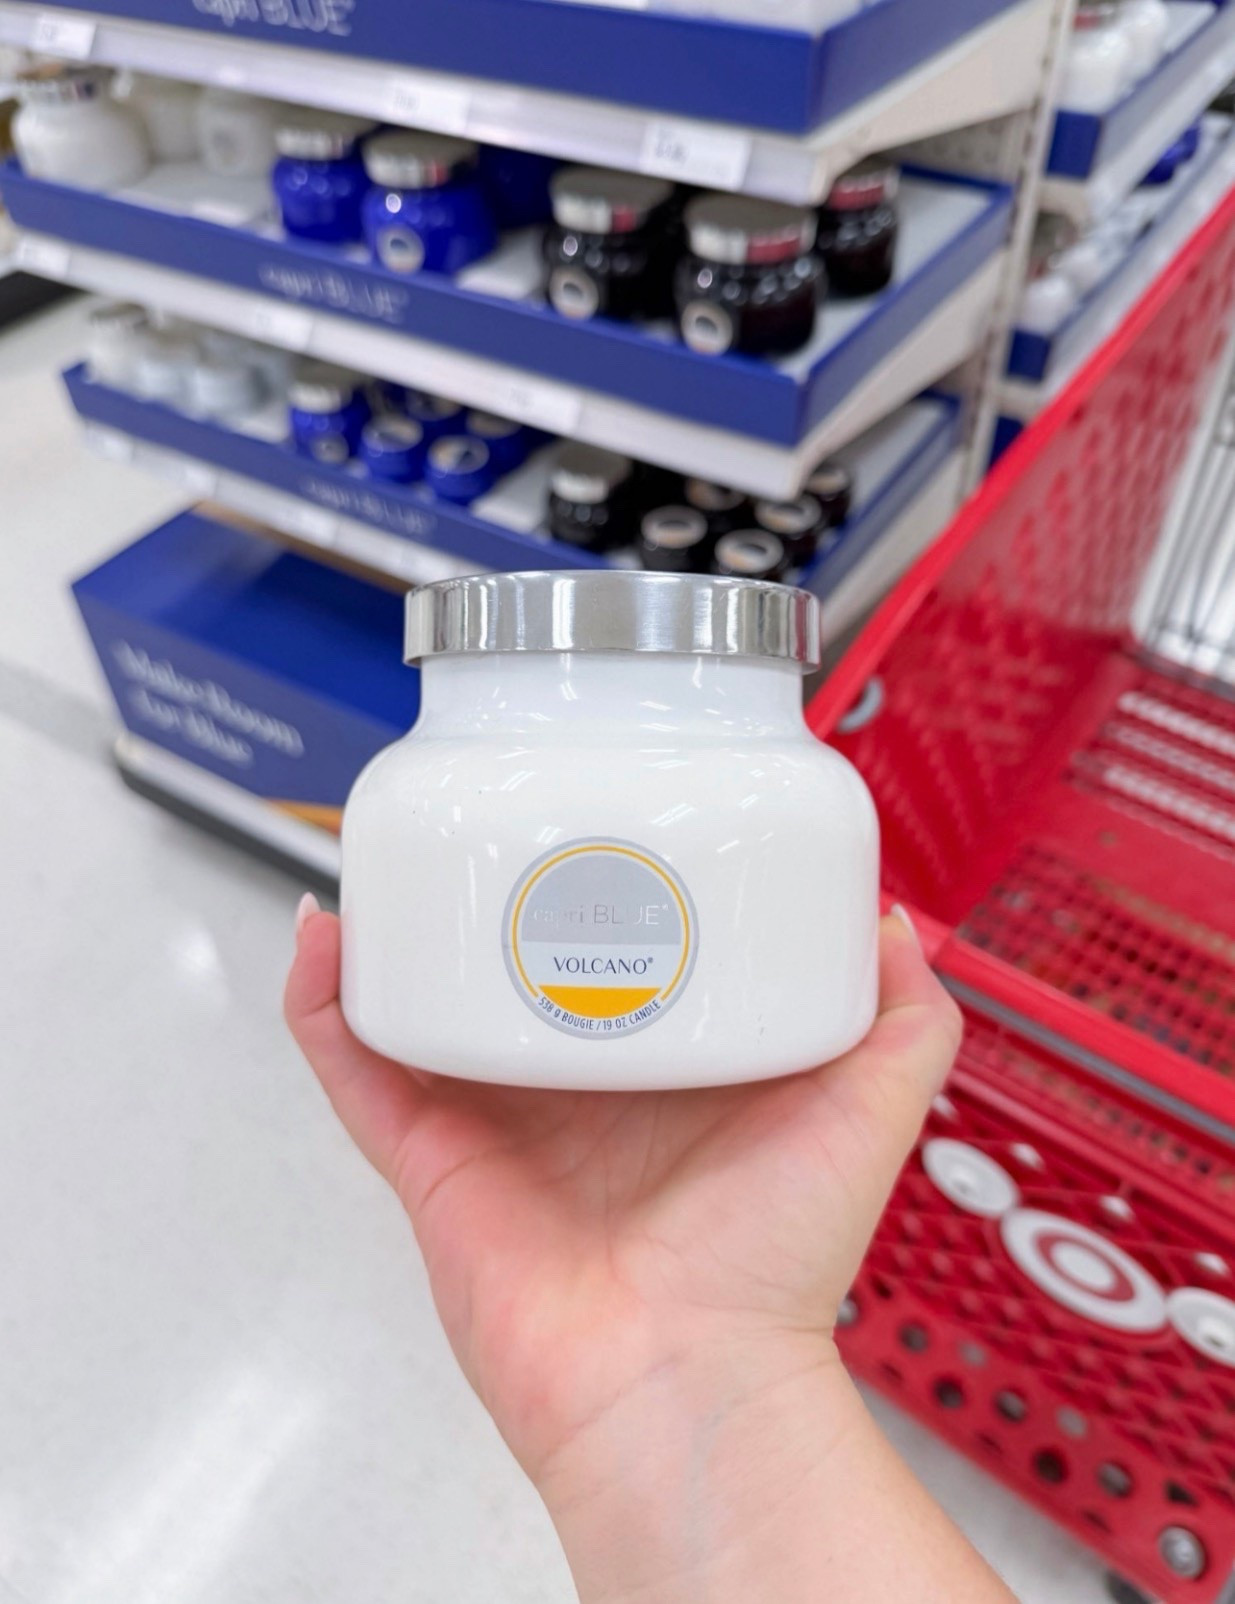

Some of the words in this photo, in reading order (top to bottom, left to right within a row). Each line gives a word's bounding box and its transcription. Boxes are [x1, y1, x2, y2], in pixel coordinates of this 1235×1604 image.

[533, 904, 584, 927] cari
[538, 997, 554, 1012] 538
[561, 1012, 594, 1030] BOUGIE
[603, 1020, 612, 1031] 19
[615, 1017, 628, 1029] OZ
[629, 999, 661, 1024] CANDLE
